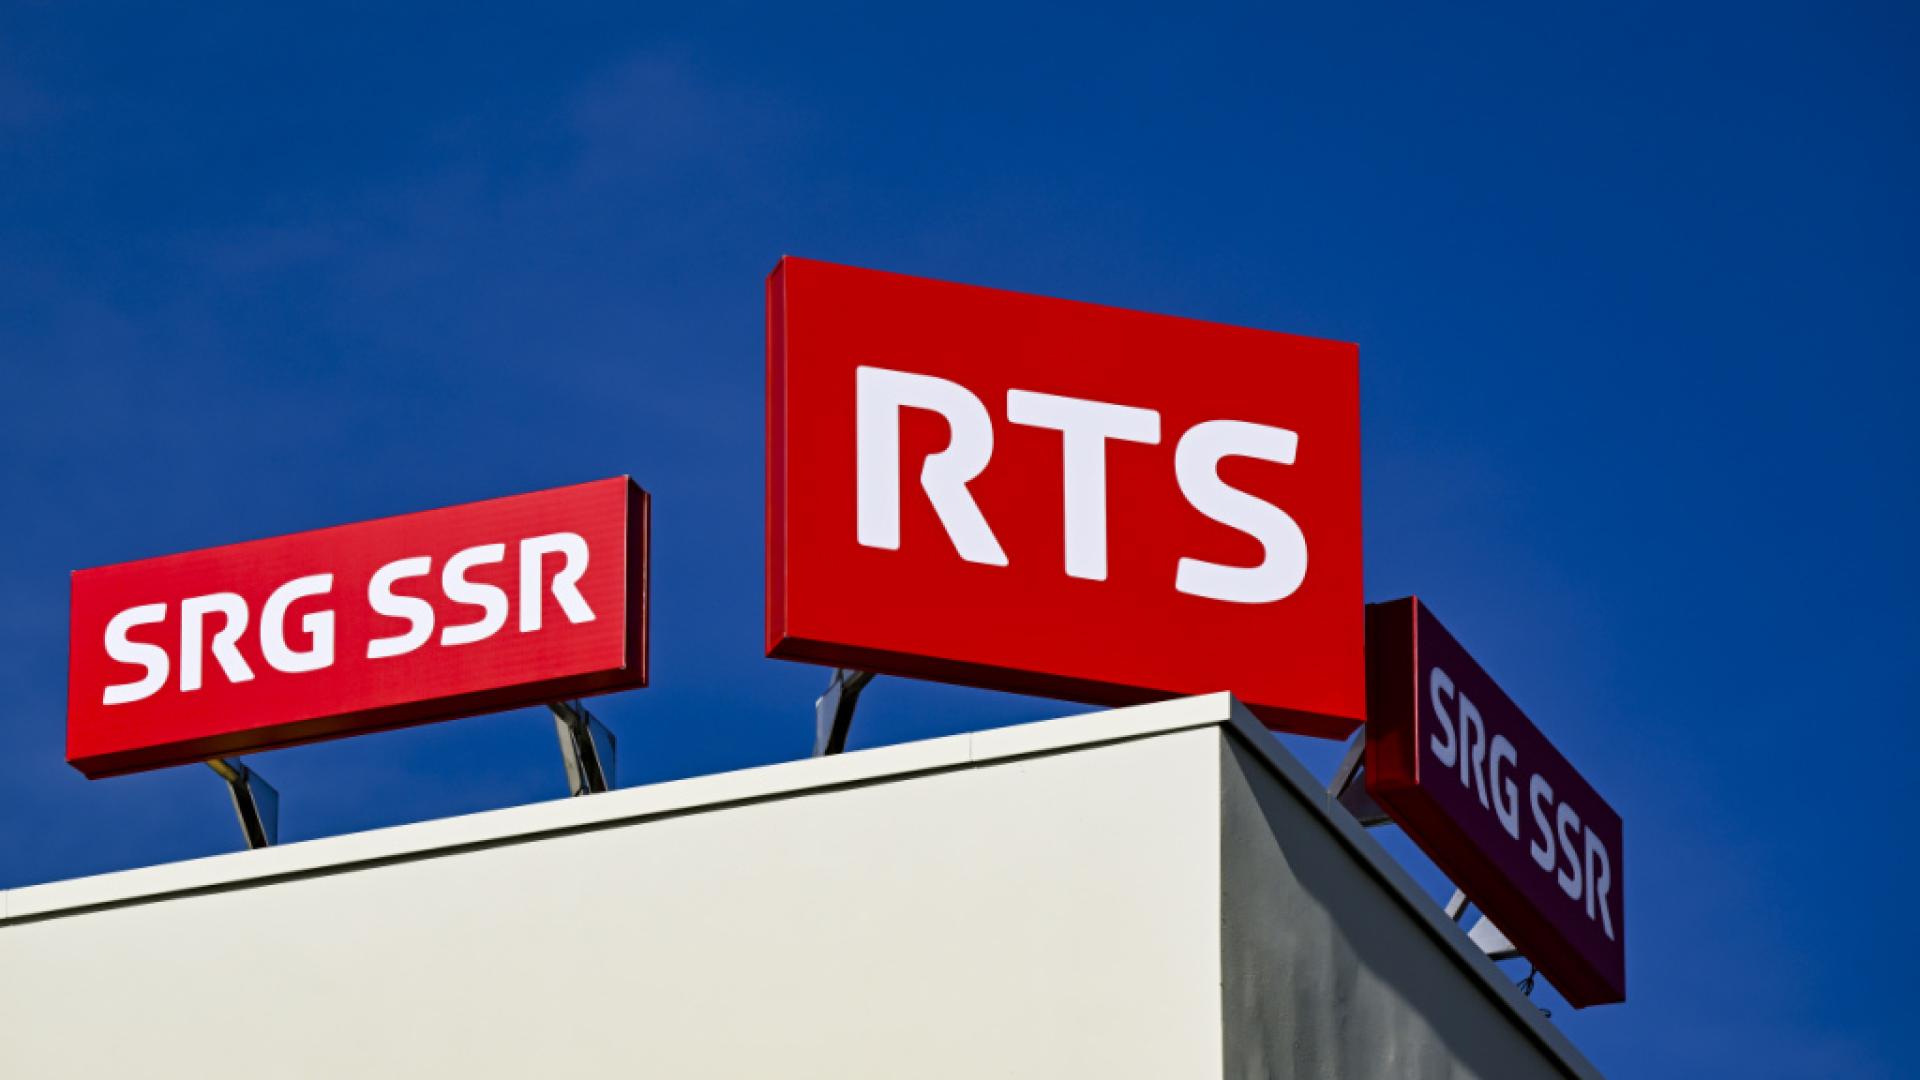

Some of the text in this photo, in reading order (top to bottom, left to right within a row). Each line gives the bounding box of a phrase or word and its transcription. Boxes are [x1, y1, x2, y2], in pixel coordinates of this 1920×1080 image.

[856, 365, 1309, 604] RTS
[102, 532, 596, 706] SRG SSR
[1430, 667, 1614, 940] SRG SSR
